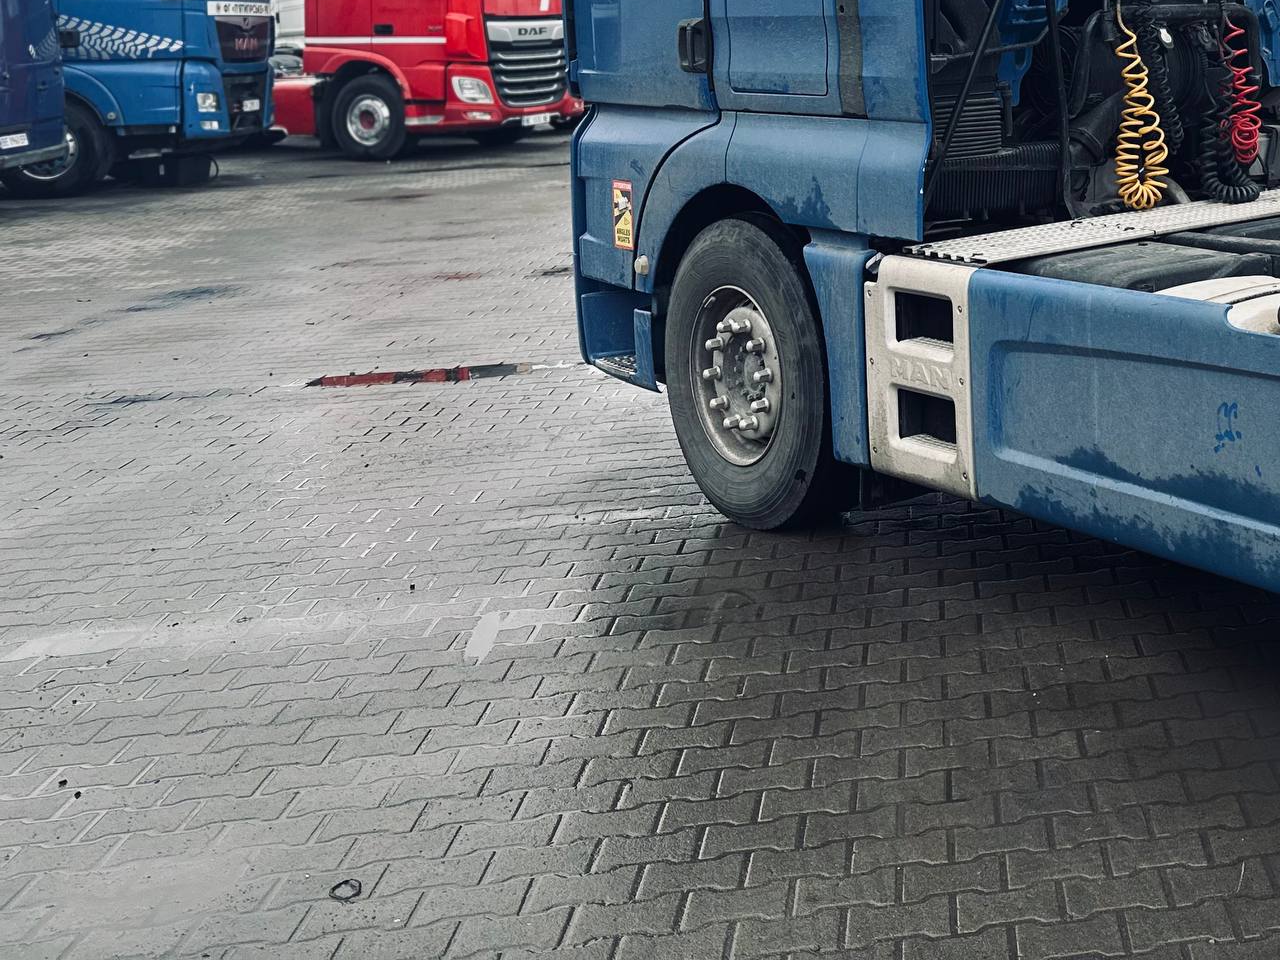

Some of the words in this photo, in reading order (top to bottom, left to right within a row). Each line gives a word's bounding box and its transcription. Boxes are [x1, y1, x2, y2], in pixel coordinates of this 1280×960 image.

[517, 27, 548, 36] DAF
[234, 37, 258, 50] MAN
[890, 357, 954, 390] MAN
